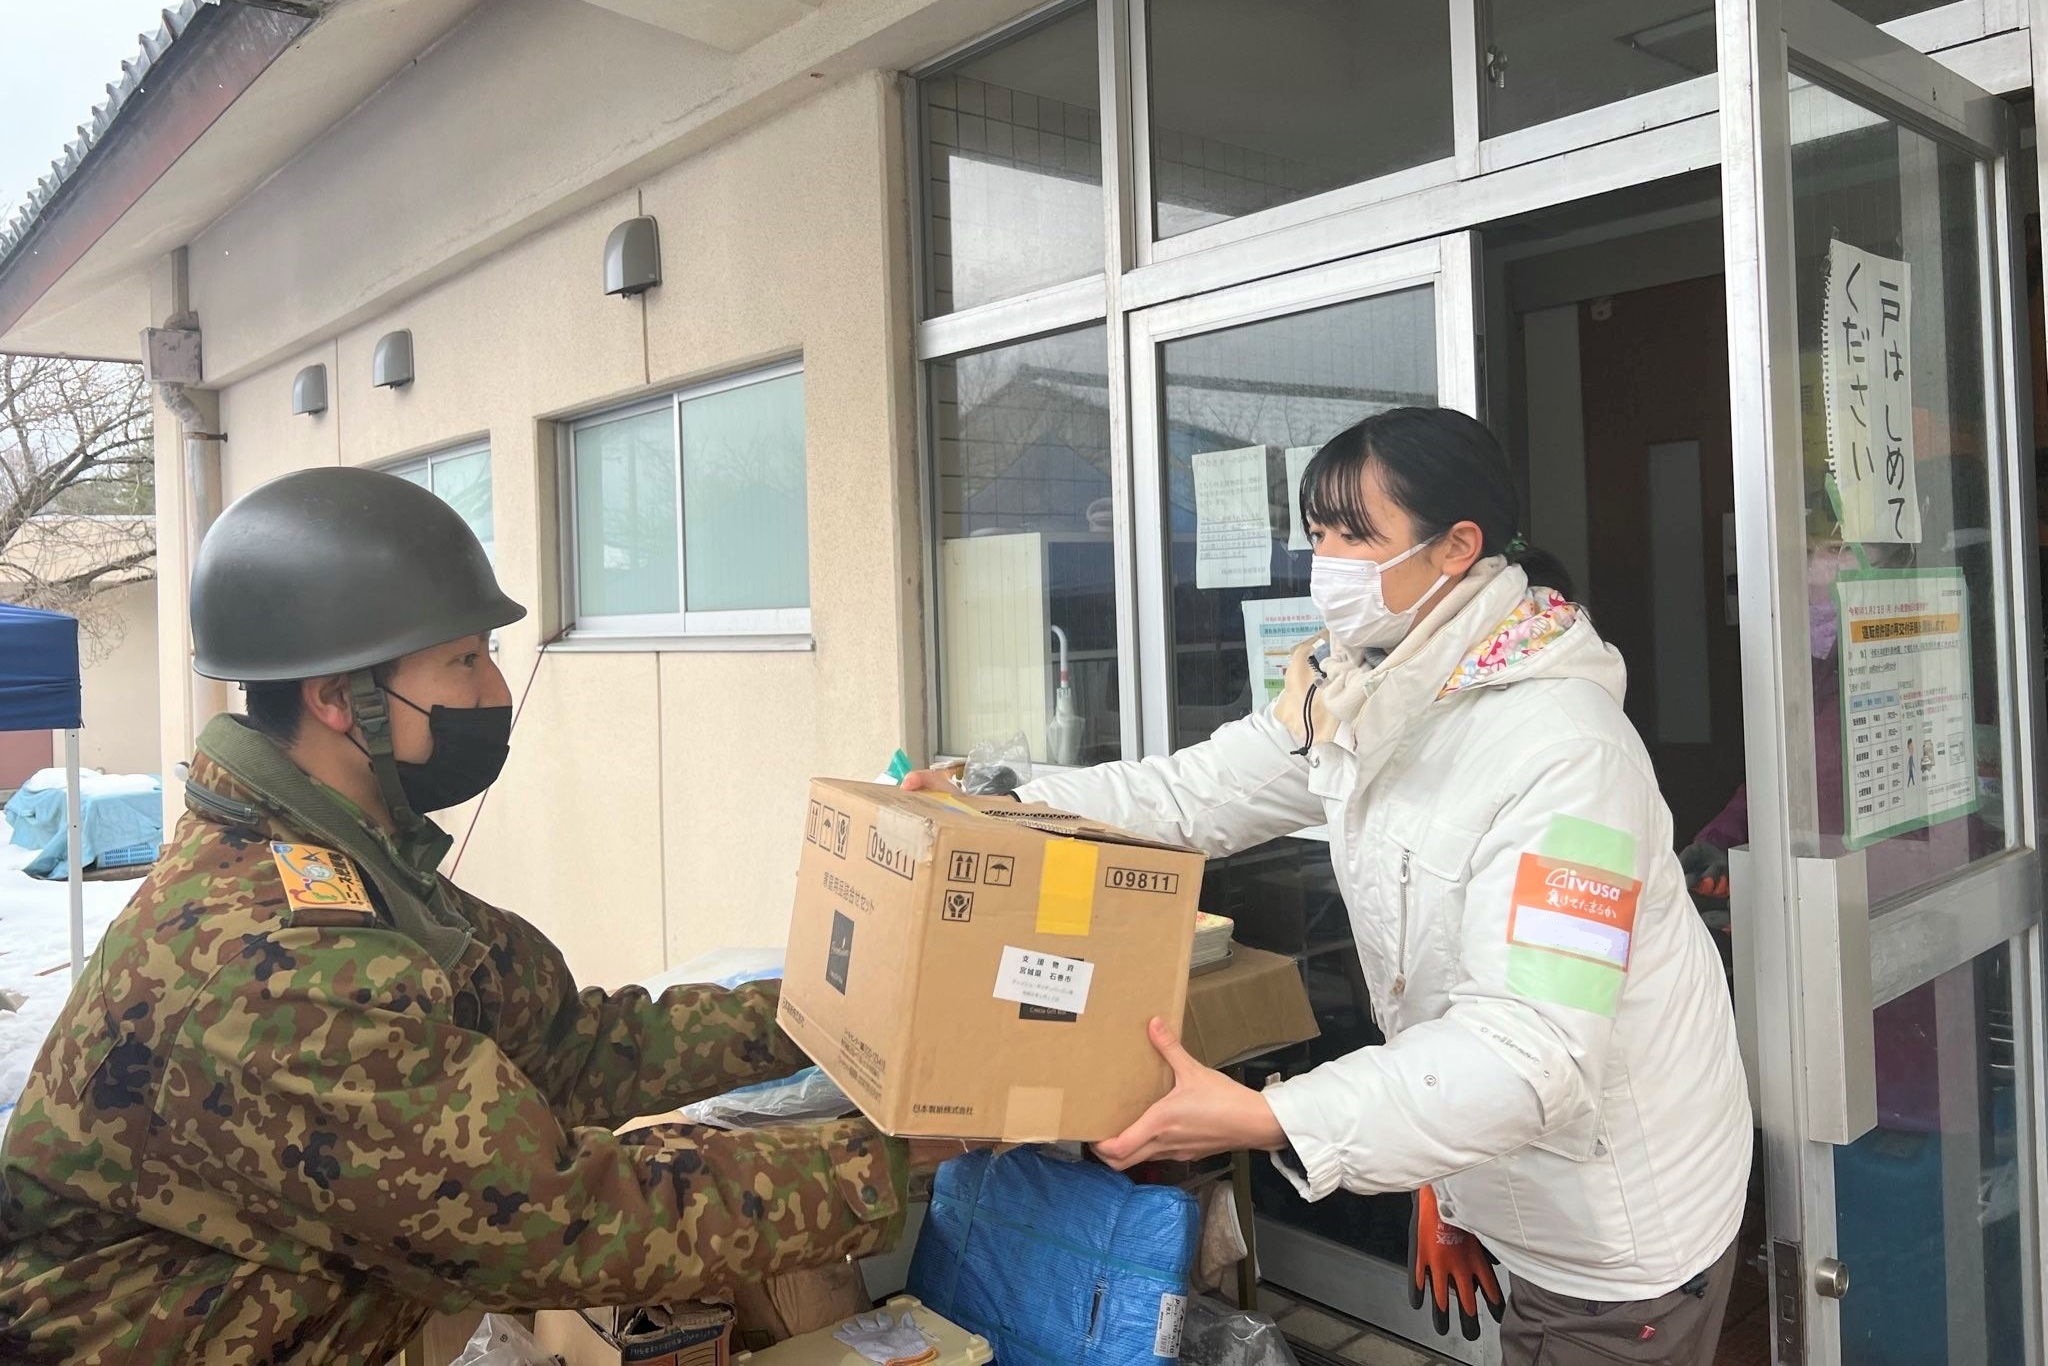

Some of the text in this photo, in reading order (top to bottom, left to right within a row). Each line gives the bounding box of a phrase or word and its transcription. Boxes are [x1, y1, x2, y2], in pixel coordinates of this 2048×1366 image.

[1842, 262, 1875, 482] ください
[1878, 279, 1906, 540] 戸はしめて
[1113, 872, 1170, 891] 09811
[1567, 869, 1622, 902] ivusa
[1019, 966, 1072, 983] 宮城県 石巻市
[912, 1103, 973, 1116] 日本製紙株式会社
